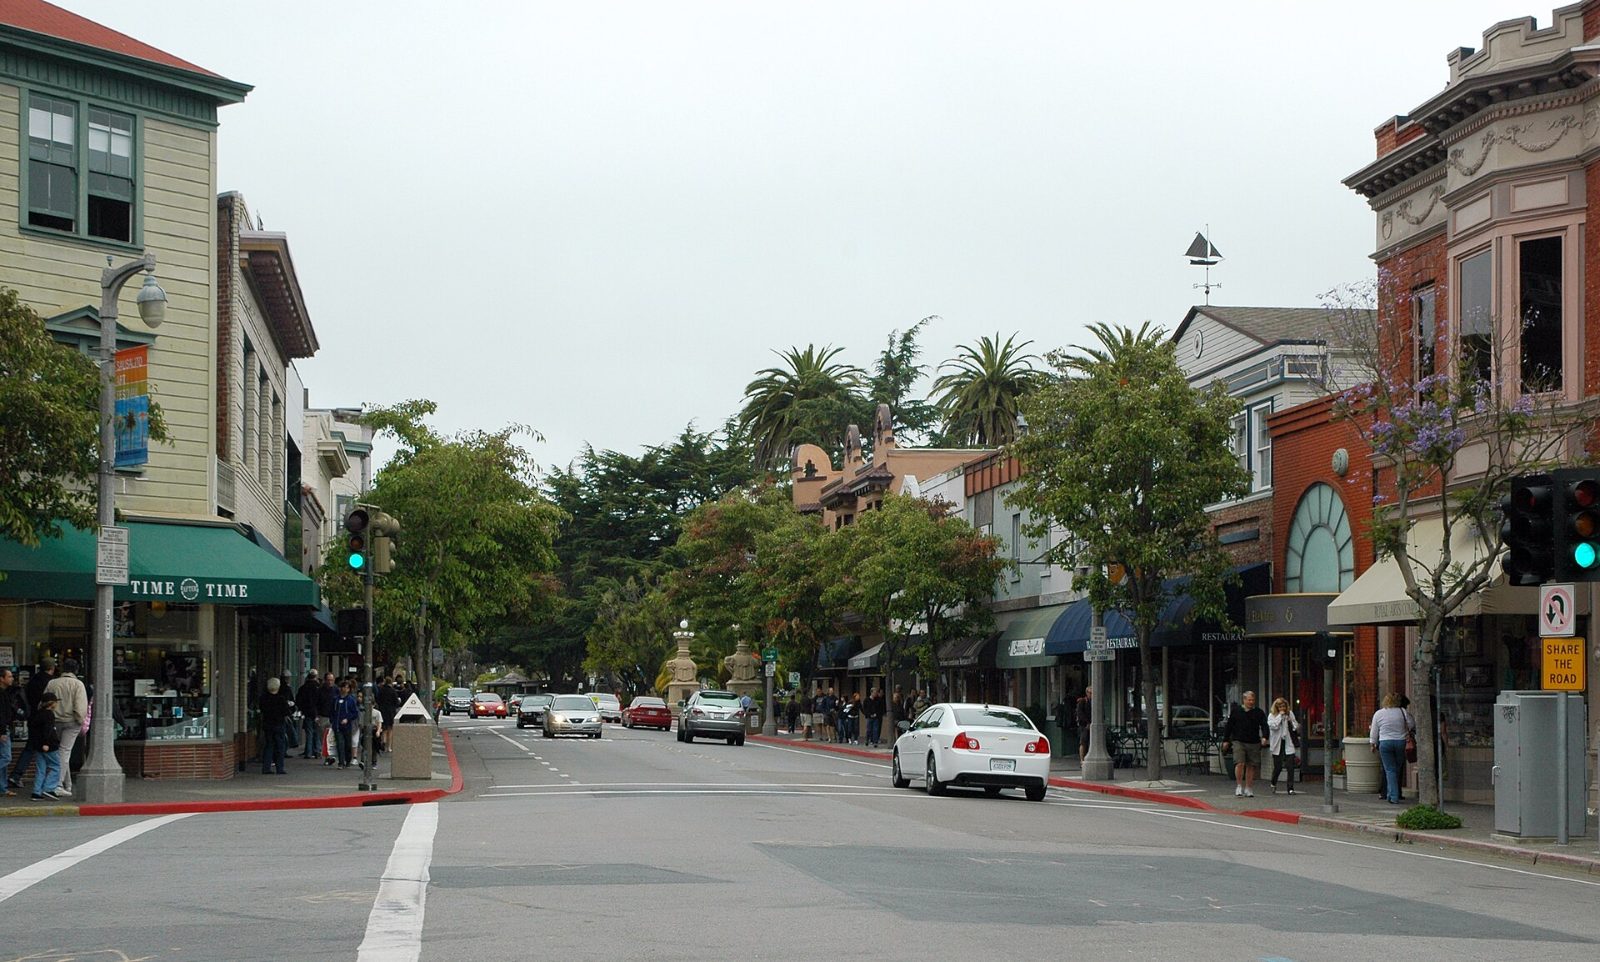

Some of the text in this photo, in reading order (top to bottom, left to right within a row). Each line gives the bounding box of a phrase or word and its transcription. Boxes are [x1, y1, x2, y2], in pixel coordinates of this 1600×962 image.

[130, 580, 175, 595] TIME
[205, 583, 248, 598] TIME
[1546, 644, 1580, 655] SHARE
[1554, 658, 1573, 669] THE
[1549, 673, 1577, 684] ROAD
